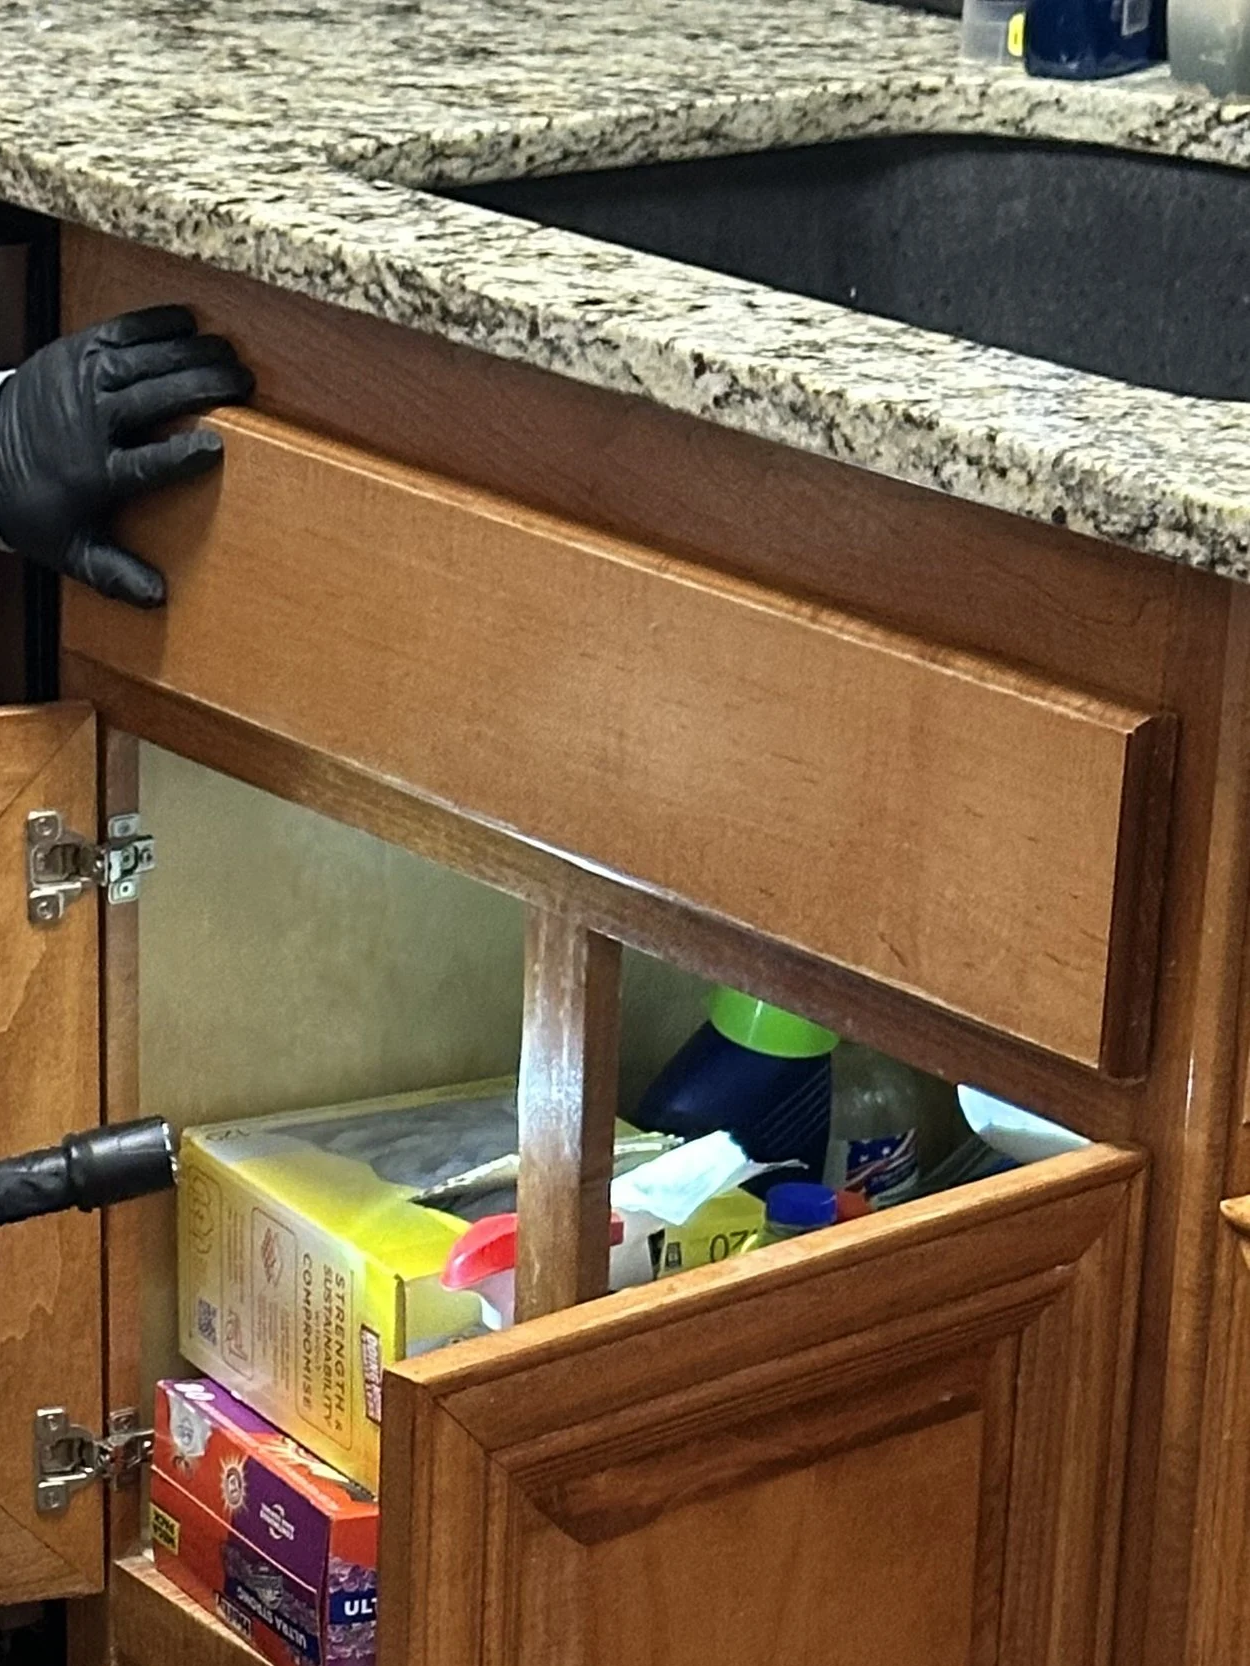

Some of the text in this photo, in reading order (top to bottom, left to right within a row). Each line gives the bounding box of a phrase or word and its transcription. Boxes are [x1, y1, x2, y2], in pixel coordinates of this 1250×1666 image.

[303, 1252, 313, 1412] COMPROMISE
[323, 1263, 332, 1428] SUSTAINABILITY
[335, 1272, 345, 1412] STRENGTH
[274, 1615, 307, 1649] ULTRA
